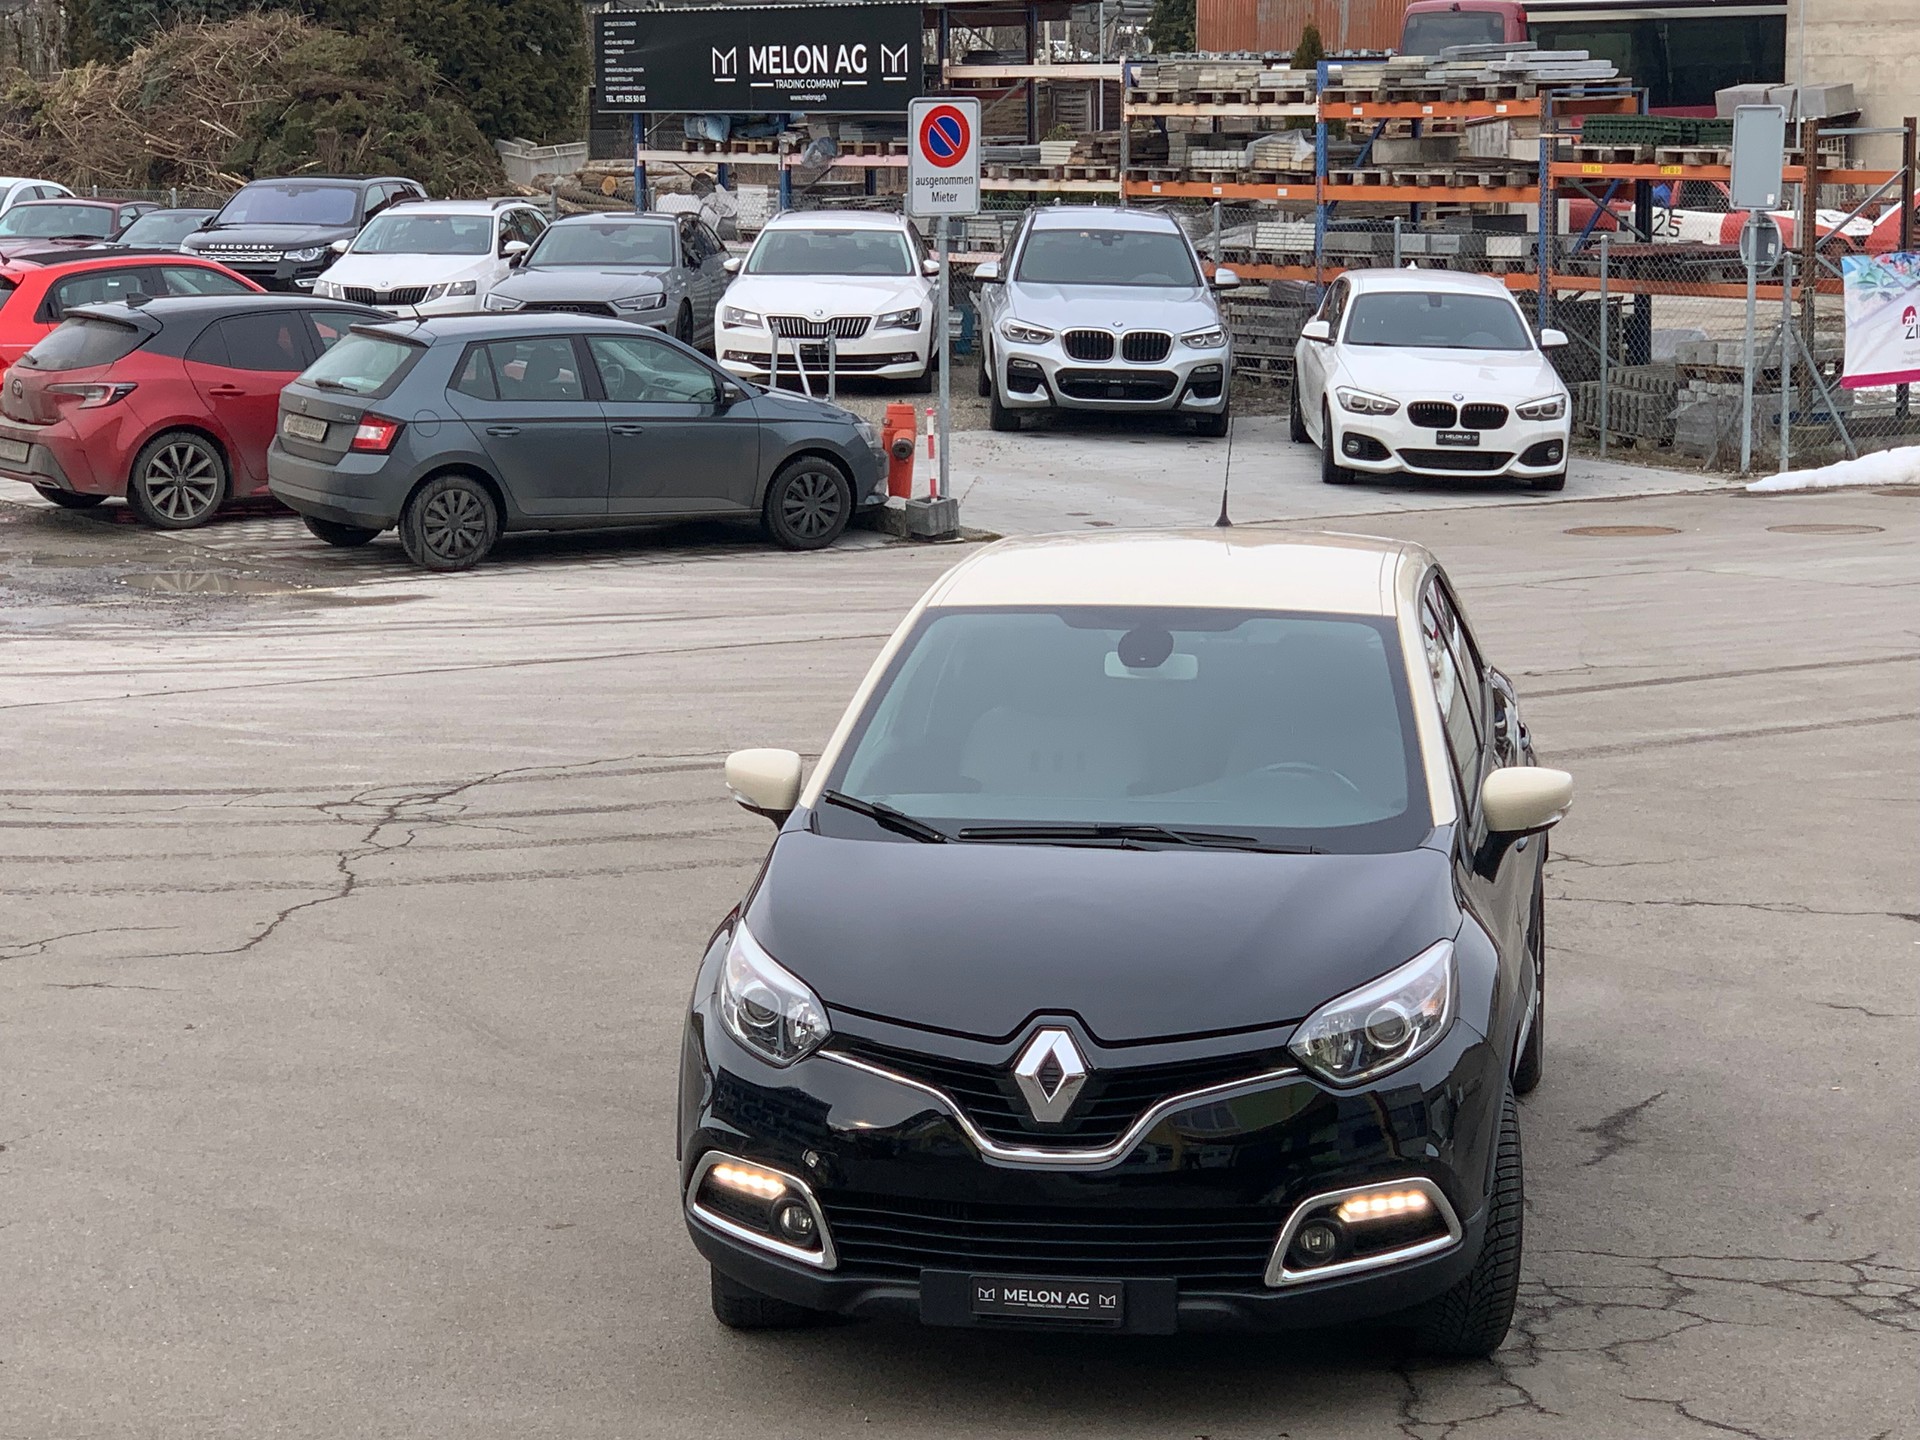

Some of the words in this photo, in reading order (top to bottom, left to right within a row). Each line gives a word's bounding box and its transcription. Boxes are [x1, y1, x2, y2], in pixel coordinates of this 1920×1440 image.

[749, 45, 828, 74] MELON
[835, 44, 867, 74] AG
[775, 80, 805, 89] TRADING
[806, 79, 840, 89] COMPANY
[790, 94, 827, 103] www.melonag.ch
[915, 176, 974, 188] ausgenommen
[931, 191, 958, 202] Mieter
[1652, 213, 1684, 237] 25
[1004, 1288, 1062, 1303] MELON
[1066, 1292, 1090, 1305] AG
